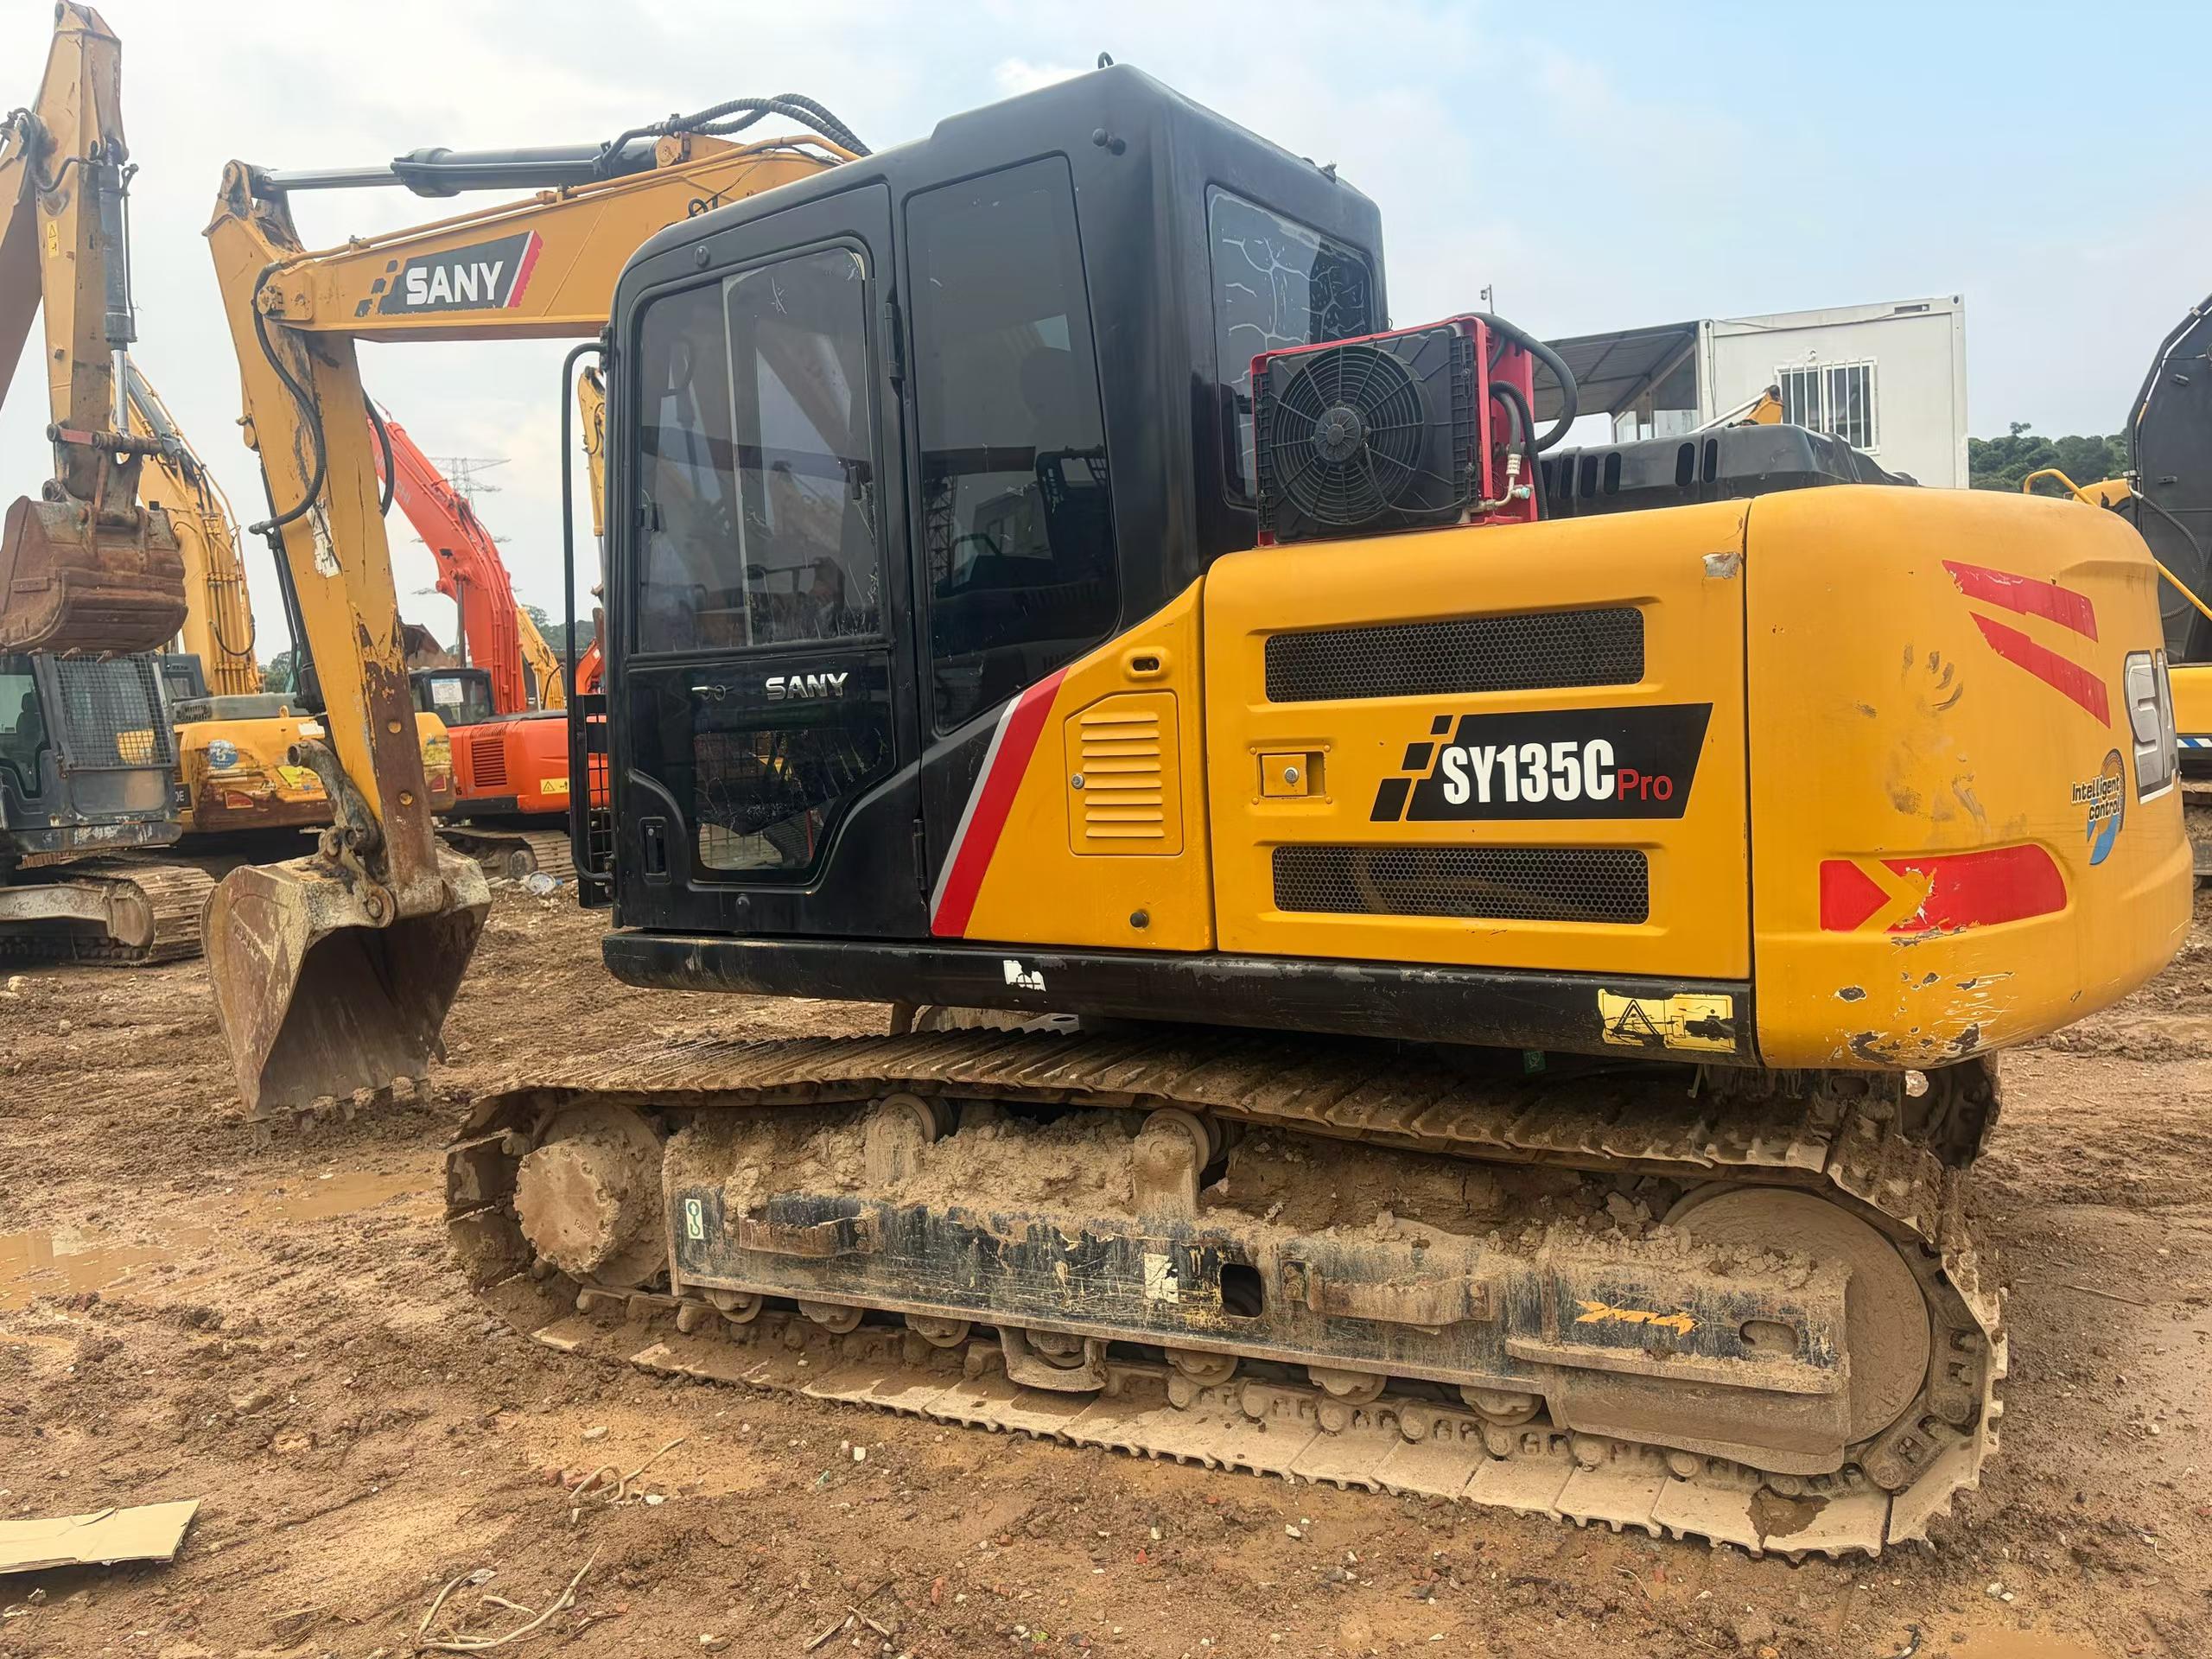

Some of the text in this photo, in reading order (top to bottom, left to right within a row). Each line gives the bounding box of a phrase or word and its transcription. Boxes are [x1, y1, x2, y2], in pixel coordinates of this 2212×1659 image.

[406, 261, 504, 305] SANY
[766, 672, 849, 701] SANY
[2071, 775, 2120, 802] Intelligent
[2088, 795, 2120, 821] control
